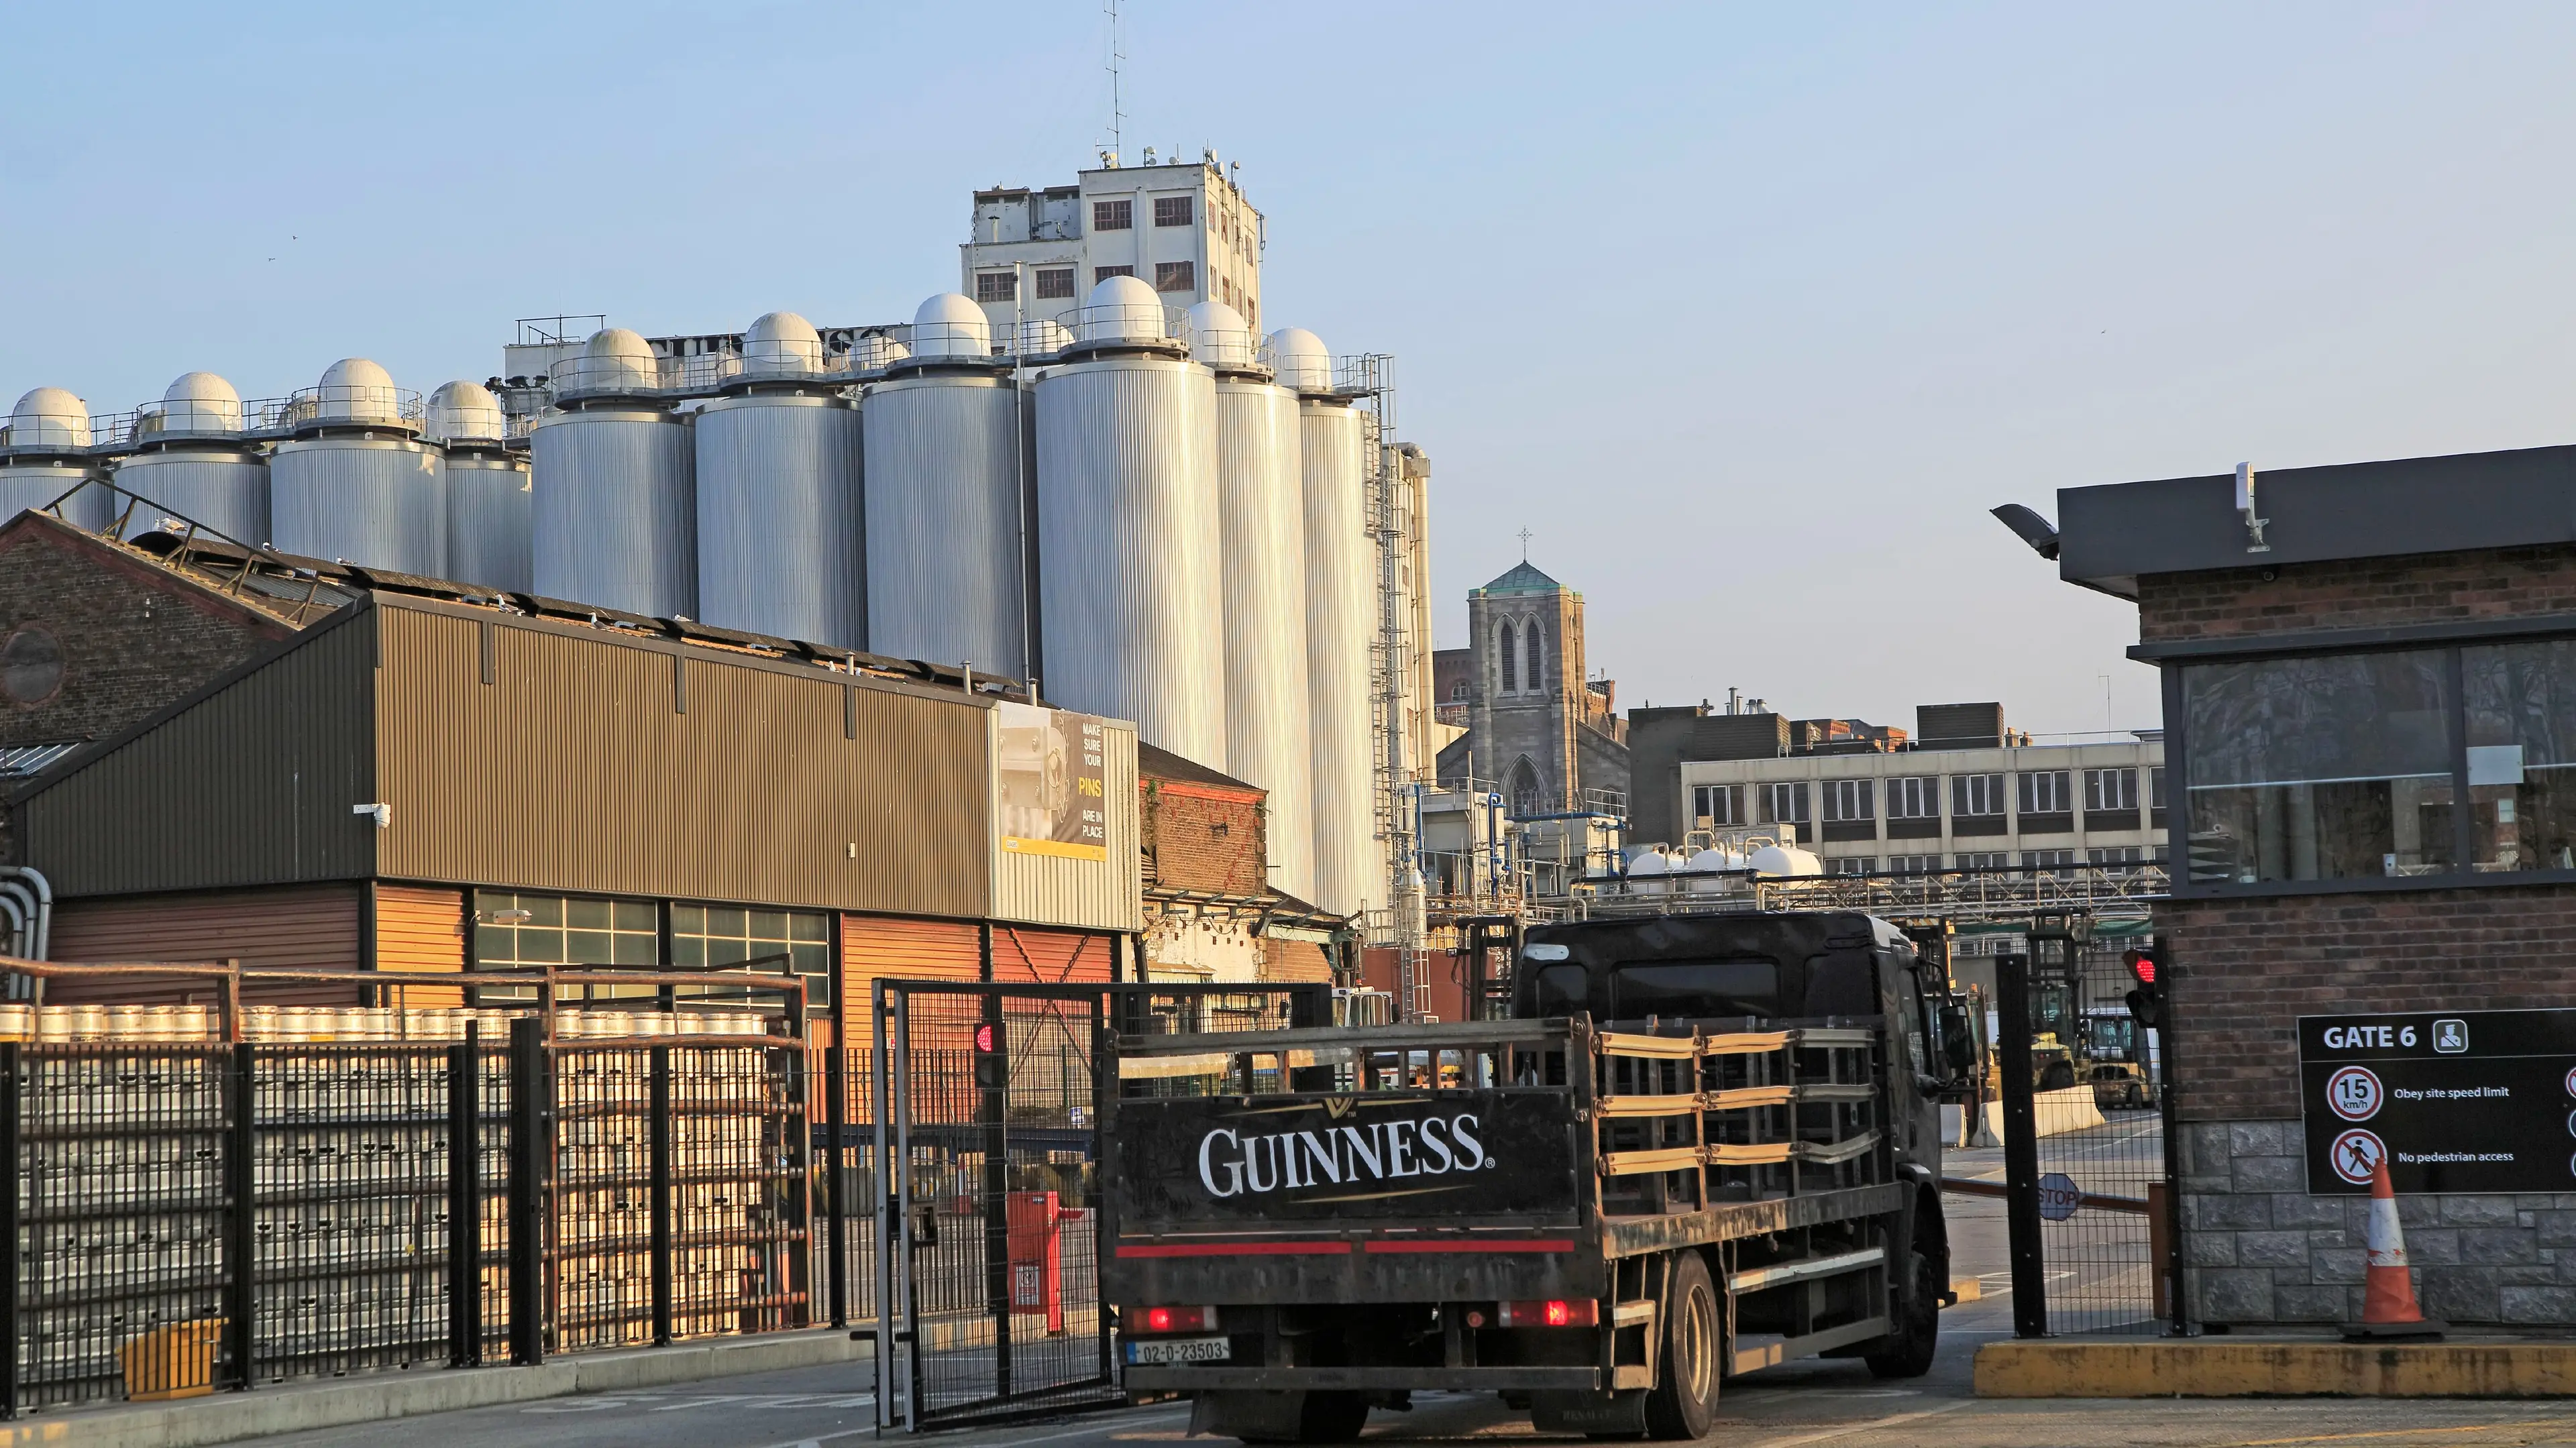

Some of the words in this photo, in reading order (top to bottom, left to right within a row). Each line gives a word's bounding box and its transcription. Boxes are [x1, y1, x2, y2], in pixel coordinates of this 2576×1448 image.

[1083, 723, 1101, 737] MAKE
[1083, 738, 1101, 752] SURE
[1083, 753, 1102, 767] YOUR
[1079, 777, 1102, 797] PINS
[1082, 810, 1095, 822] ARE
[1095, 811, 1102, 823] IN
[1082, 824, 1103, 838] PLACE
[2324, 1025, 2394, 1048] GATE
[2400, 1025, 2417, 1047] 6
[2339, 1078, 2369, 1100] 15
[2394, 1088, 2424, 1101] Obey
[2425, 1087, 2446, 1099] site
[2448, 1087, 2481, 1100] speed
[2483, 1086, 2510, 1098] limit
[2343, 1100, 2368, 1109] km/h
[1199, 1113, 1484, 1197] GUINNESS
[2398, 1152, 2414, 1162] No
[2417, 1151, 2476, 1165] pedestrian
[2478, 1152, 2514, 1162] access
[2039, 1187, 2076, 1205] STOP
[1143, 1343, 1222, 1362] 02-D-23503
[1562, 1409, 1612, 1421] RENAT
